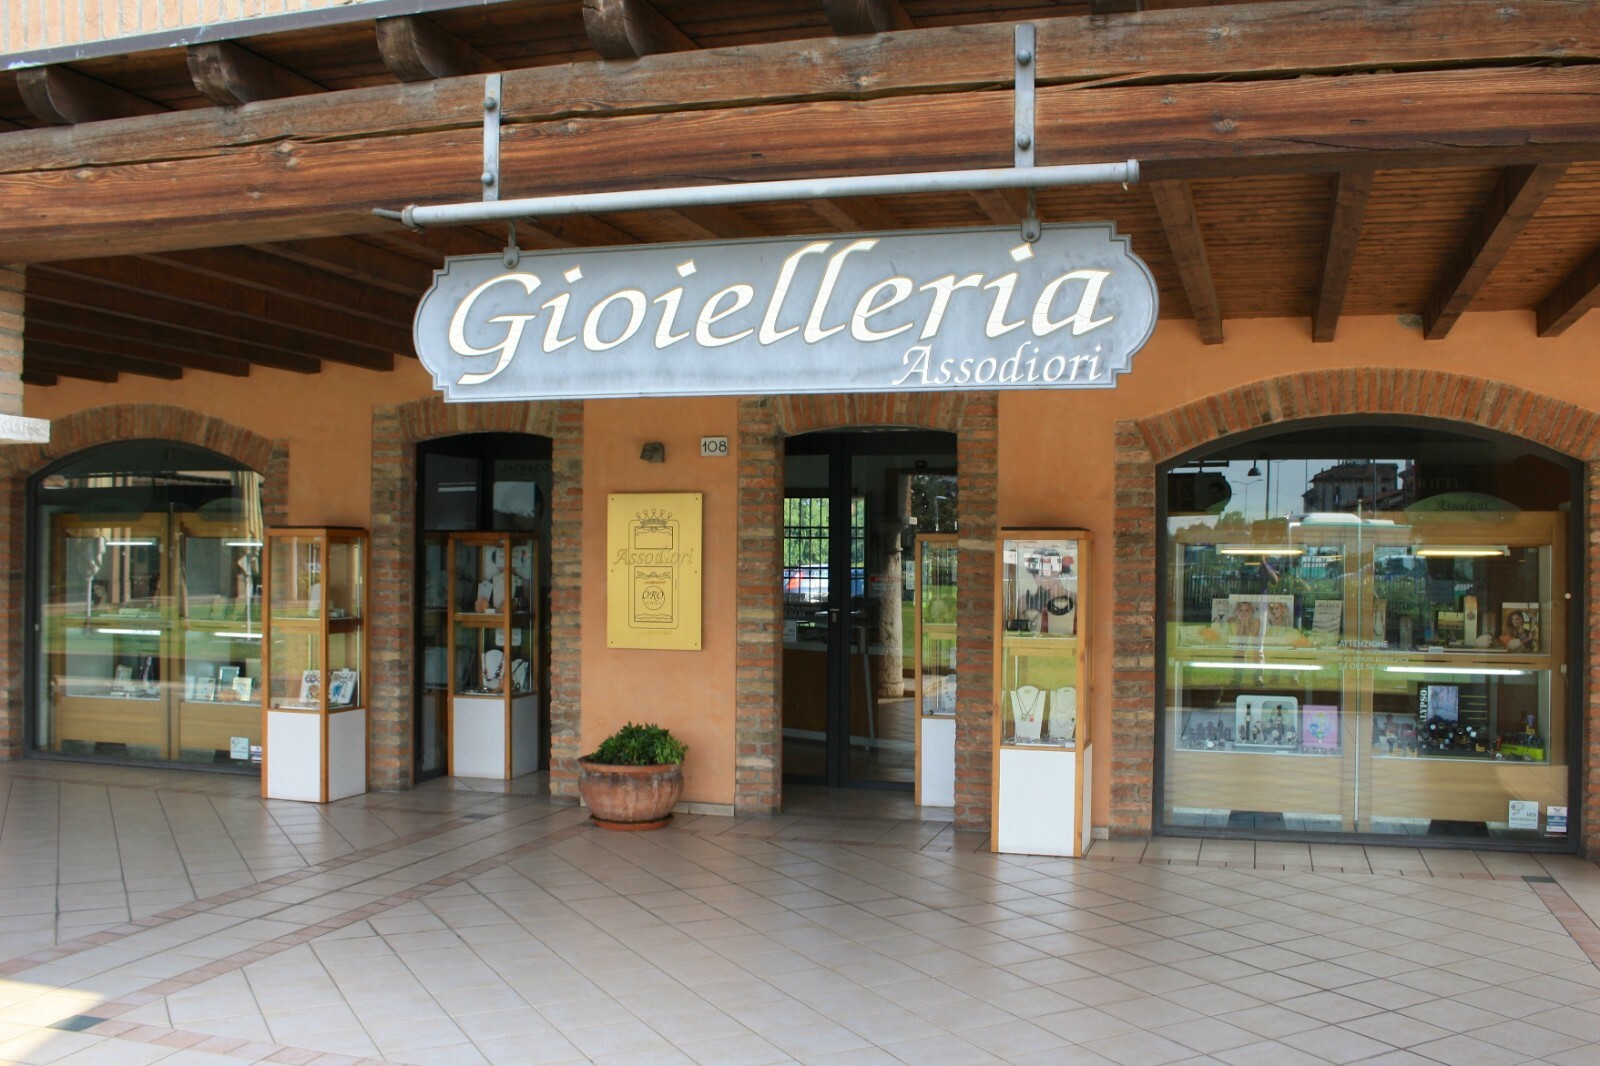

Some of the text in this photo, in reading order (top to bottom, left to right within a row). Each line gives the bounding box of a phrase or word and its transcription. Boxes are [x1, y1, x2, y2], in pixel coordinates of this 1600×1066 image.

[448, 240, 1115, 385] Gioielleria
[892, 341, 1103, 387] Assodiori
[702, 440, 727, 453] 108
[1435, 499, 1488, 512] Assodiori
[613, 547, 694, 566] Assodiori
[642, 591, 665, 601] ORO
[1338, 640, 1389, 649] ATTENZIONE
[1419, 689, 1428, 723] ALYPSO
